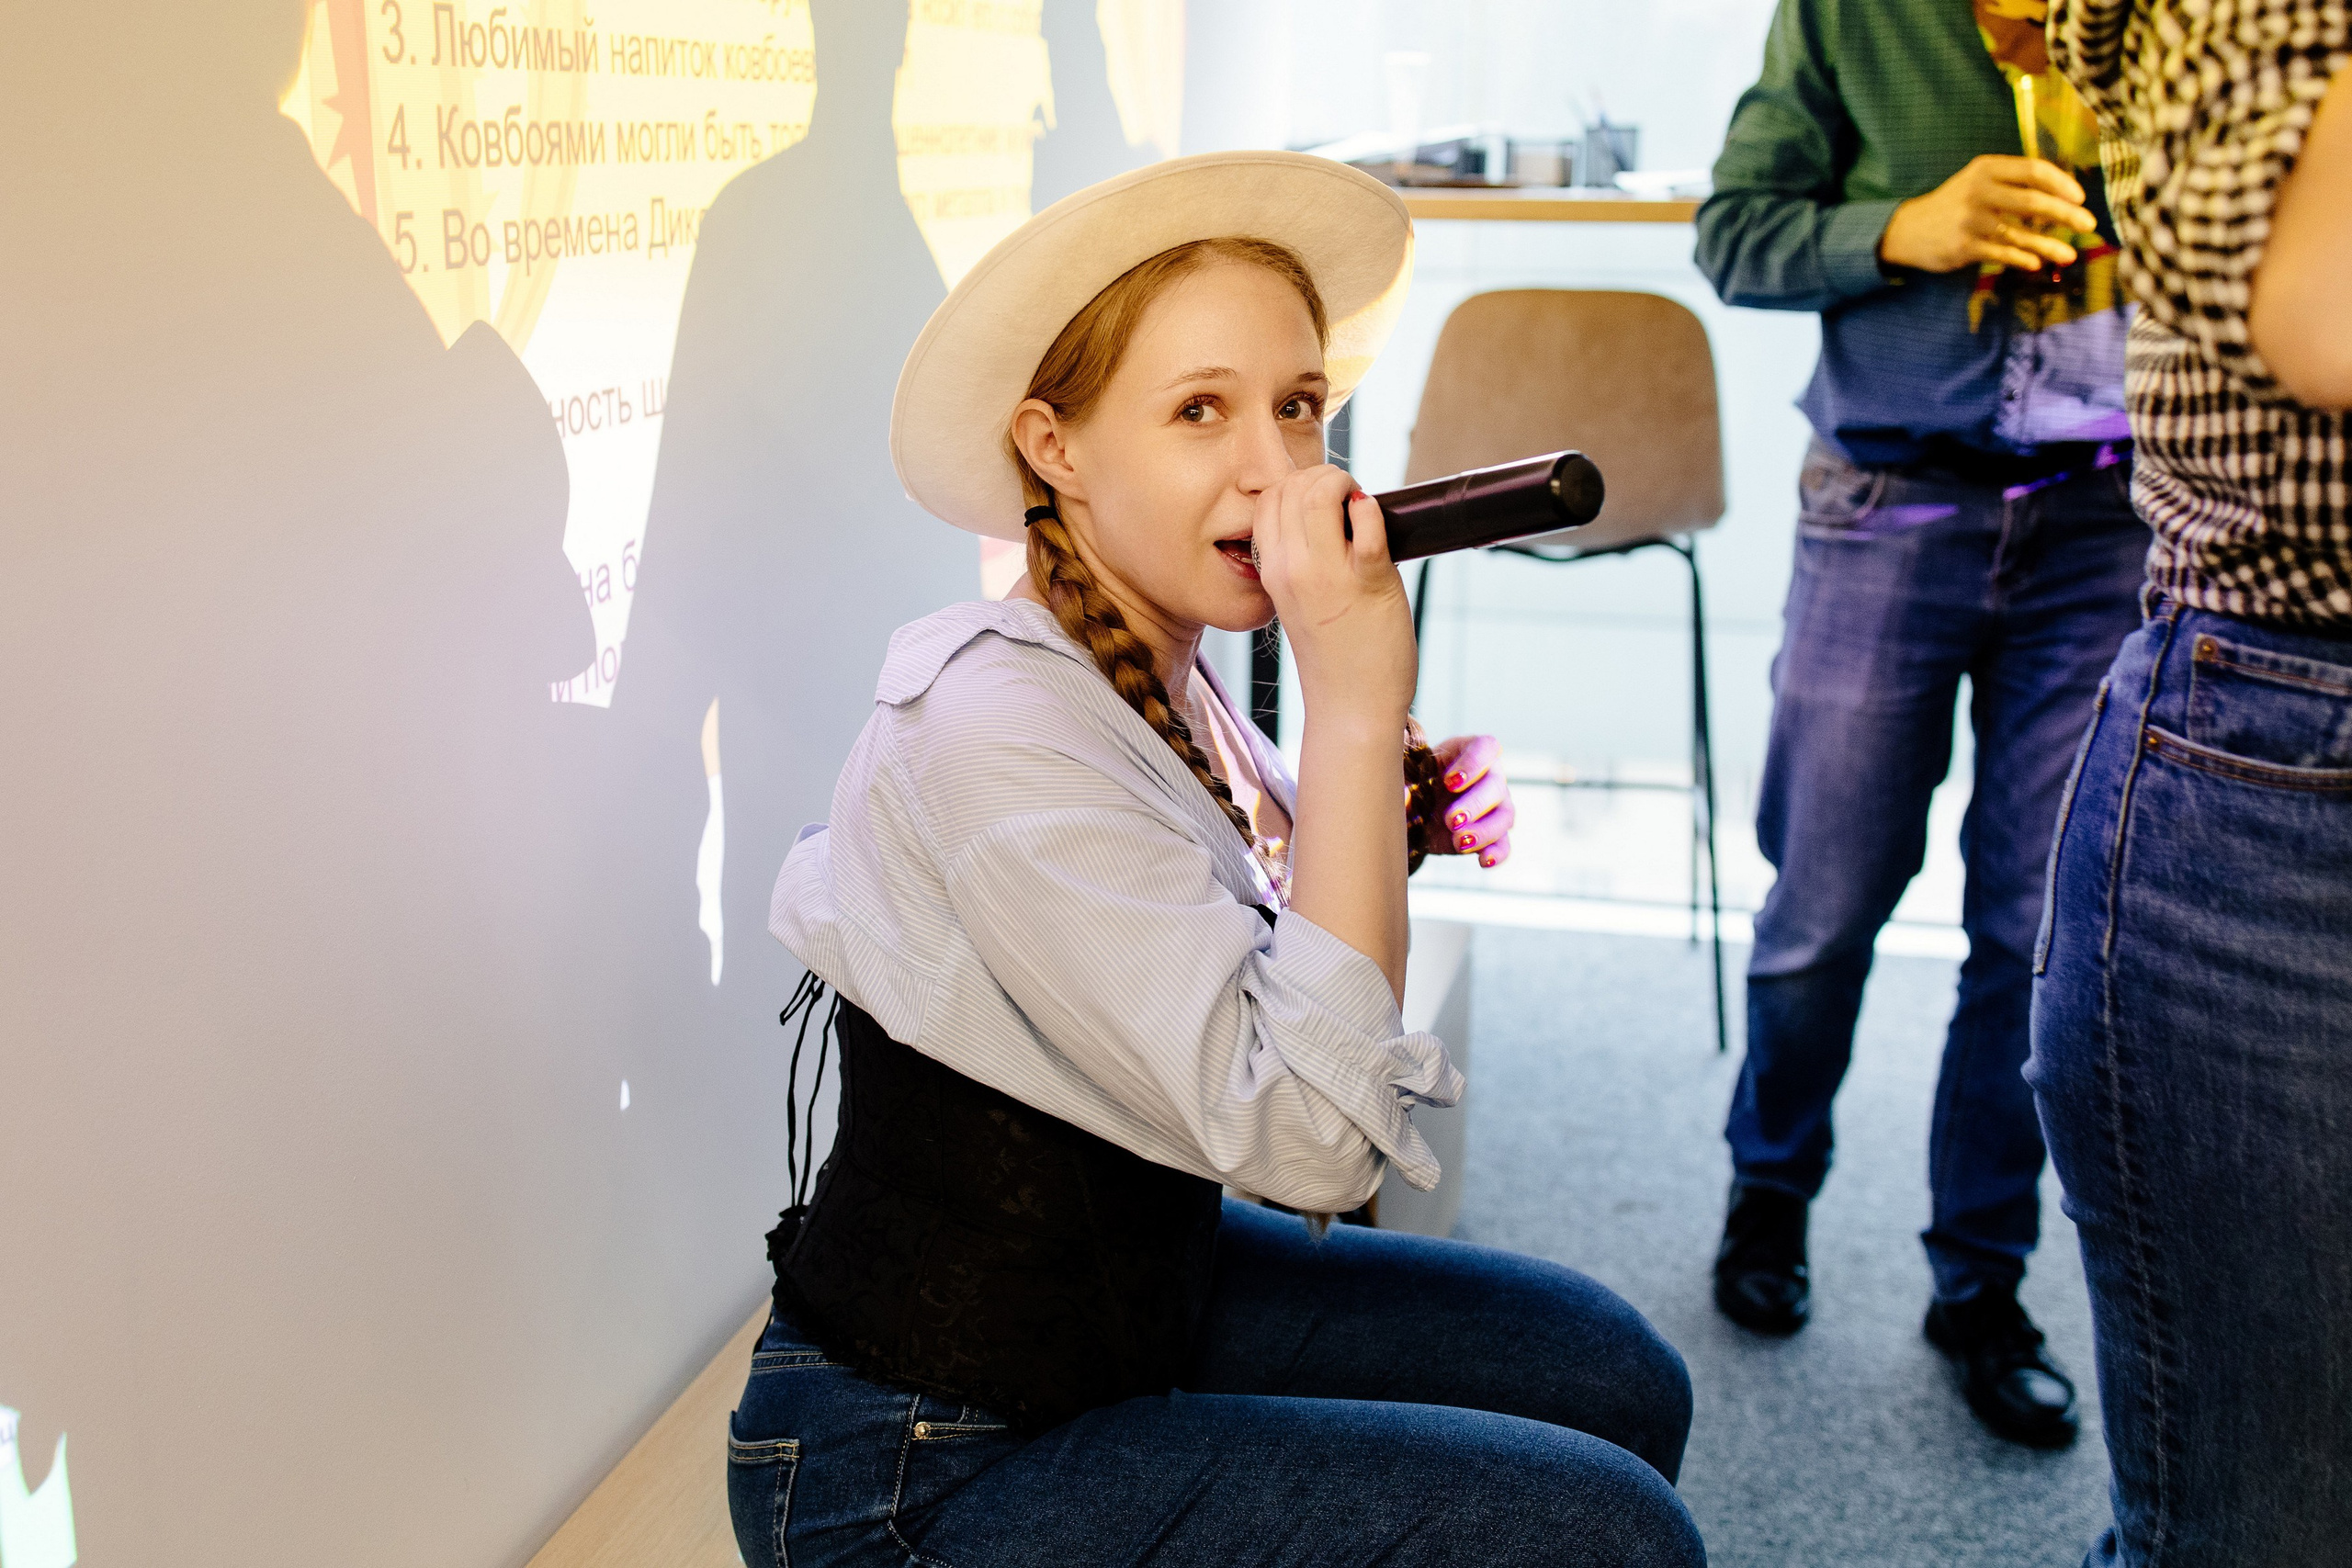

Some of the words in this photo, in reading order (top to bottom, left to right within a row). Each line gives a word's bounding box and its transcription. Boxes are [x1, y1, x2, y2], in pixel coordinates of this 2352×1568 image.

[381, 0, 418, 65] 3.
[431, 3, 599, 73] Любимый
[610, 33, 718, 80] напиток
[723, 32, 816, 84] ковбоев
[387, 103, 424, 171] 4.
[436, 105, 607, 170] Ковбоями
[616, 119, 696, 165] могли
[704, 107, 763, 162] быть
[394, 210, 430, 275] 5.
[443, 208, 491, 272] Во
[503, 213, 639, 276] времена
